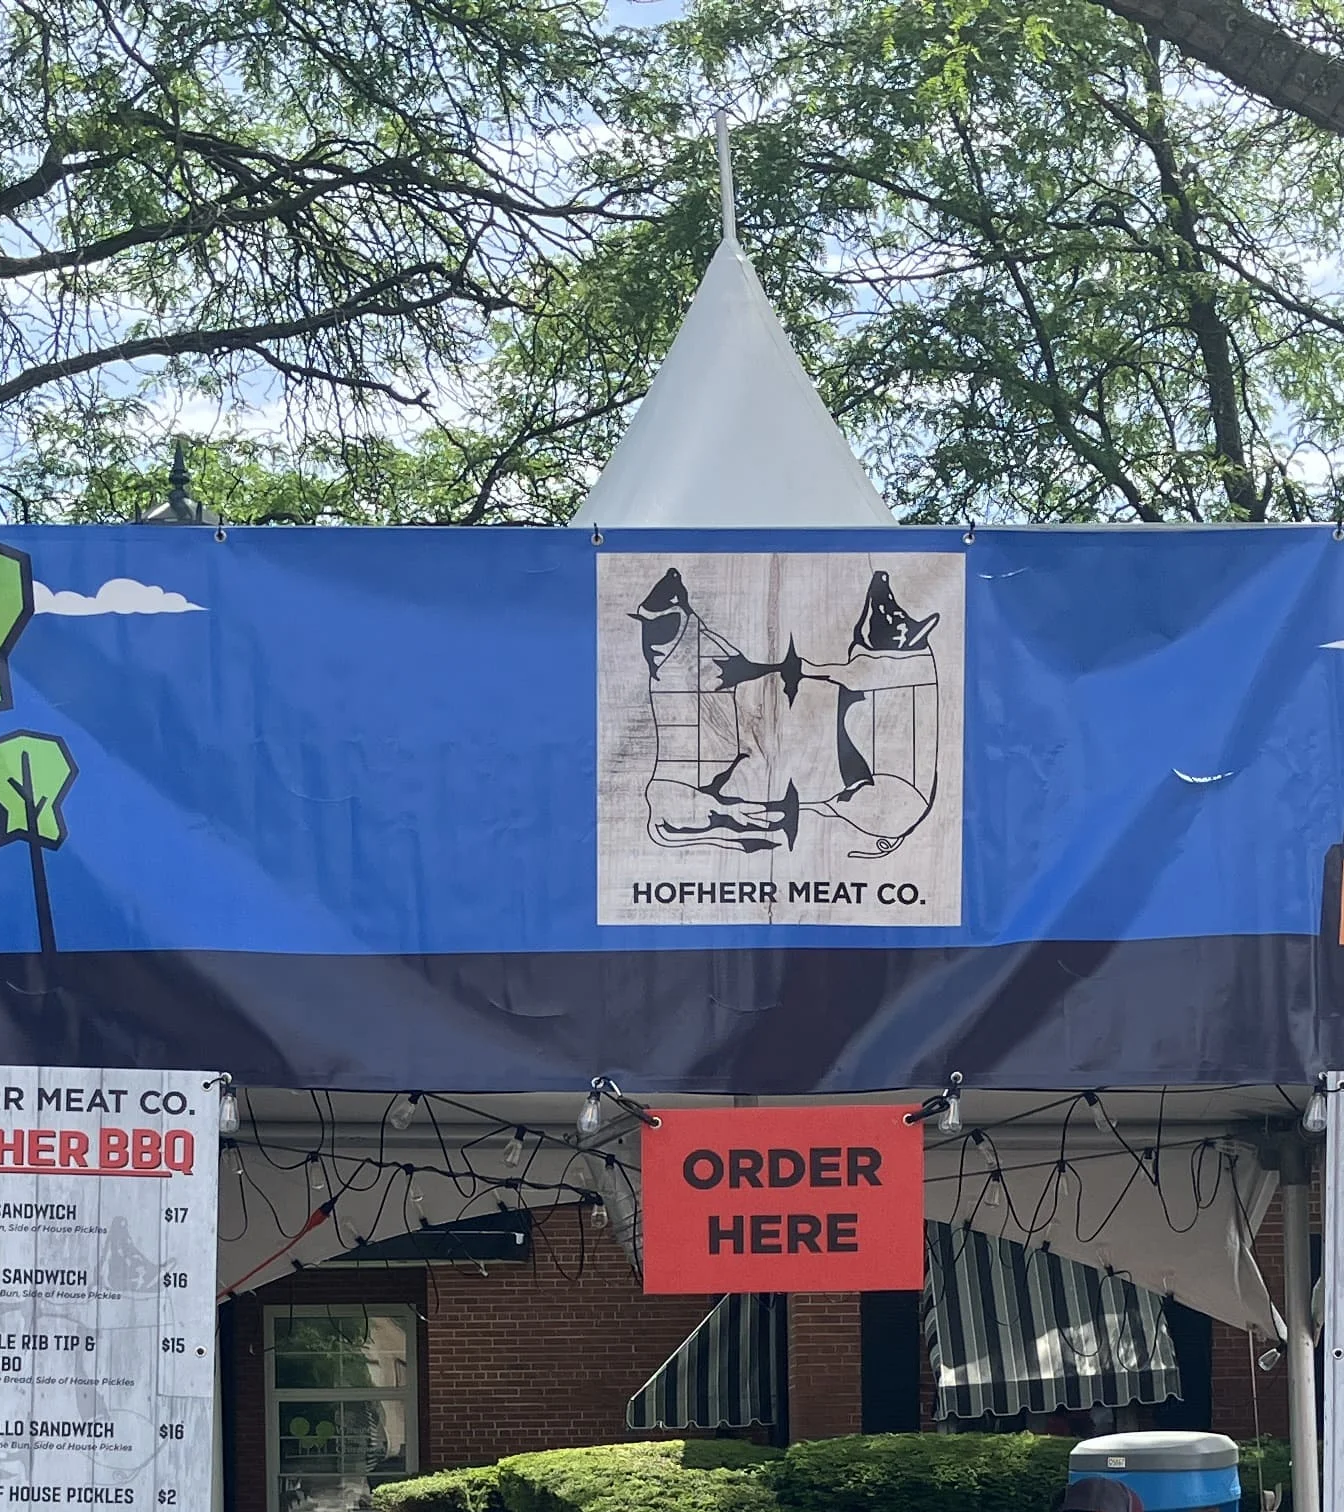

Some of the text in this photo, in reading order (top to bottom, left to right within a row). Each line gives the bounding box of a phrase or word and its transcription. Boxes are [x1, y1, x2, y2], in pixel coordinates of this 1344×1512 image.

[633, 881, 926, 905] HOFHERR MEAT CO.
[38, 1088, 128, 1113] MEAT
[140, 1091, 195, 1115] CO.
[100, 1128, 194, 1176] BBQ
[682, 1147, 883, 1190] ORDER
[164, 1207, 188, 1223] $17
[708, 1213, 859, 1254] HERE
[2, 1268, 87, 1286] SANDWICH
[163, 1272, 188, 1289] $16
[23, 1289, 42, 1298] Side
[44, 1290, 56, 1298] of
[57, 1290, 86, 1299] House
[88, 1291, 121, 1300] Pickles
[22, 1334, 48, 1351] RIB
[54, 1335, 80, 1351] TIP
[85, 1336, 96, 1351] &
[162, 1337, 185, 1353] $15
[36, 1376, 56, 1385] Side
[58, 1376, 69, 1385] of
[70, 1377, 99, 1386] House
[102, 1377, 134, 1386] Pickles
[29, 1420, 114, 1438] SANDWICH
[159, 1424, 184, 1440] $16
[9, 1486, 61, 1503] HOUSE
[67, 1487, 134, 1504] PICKLES
[158, 1489, 177, 1505] $2
